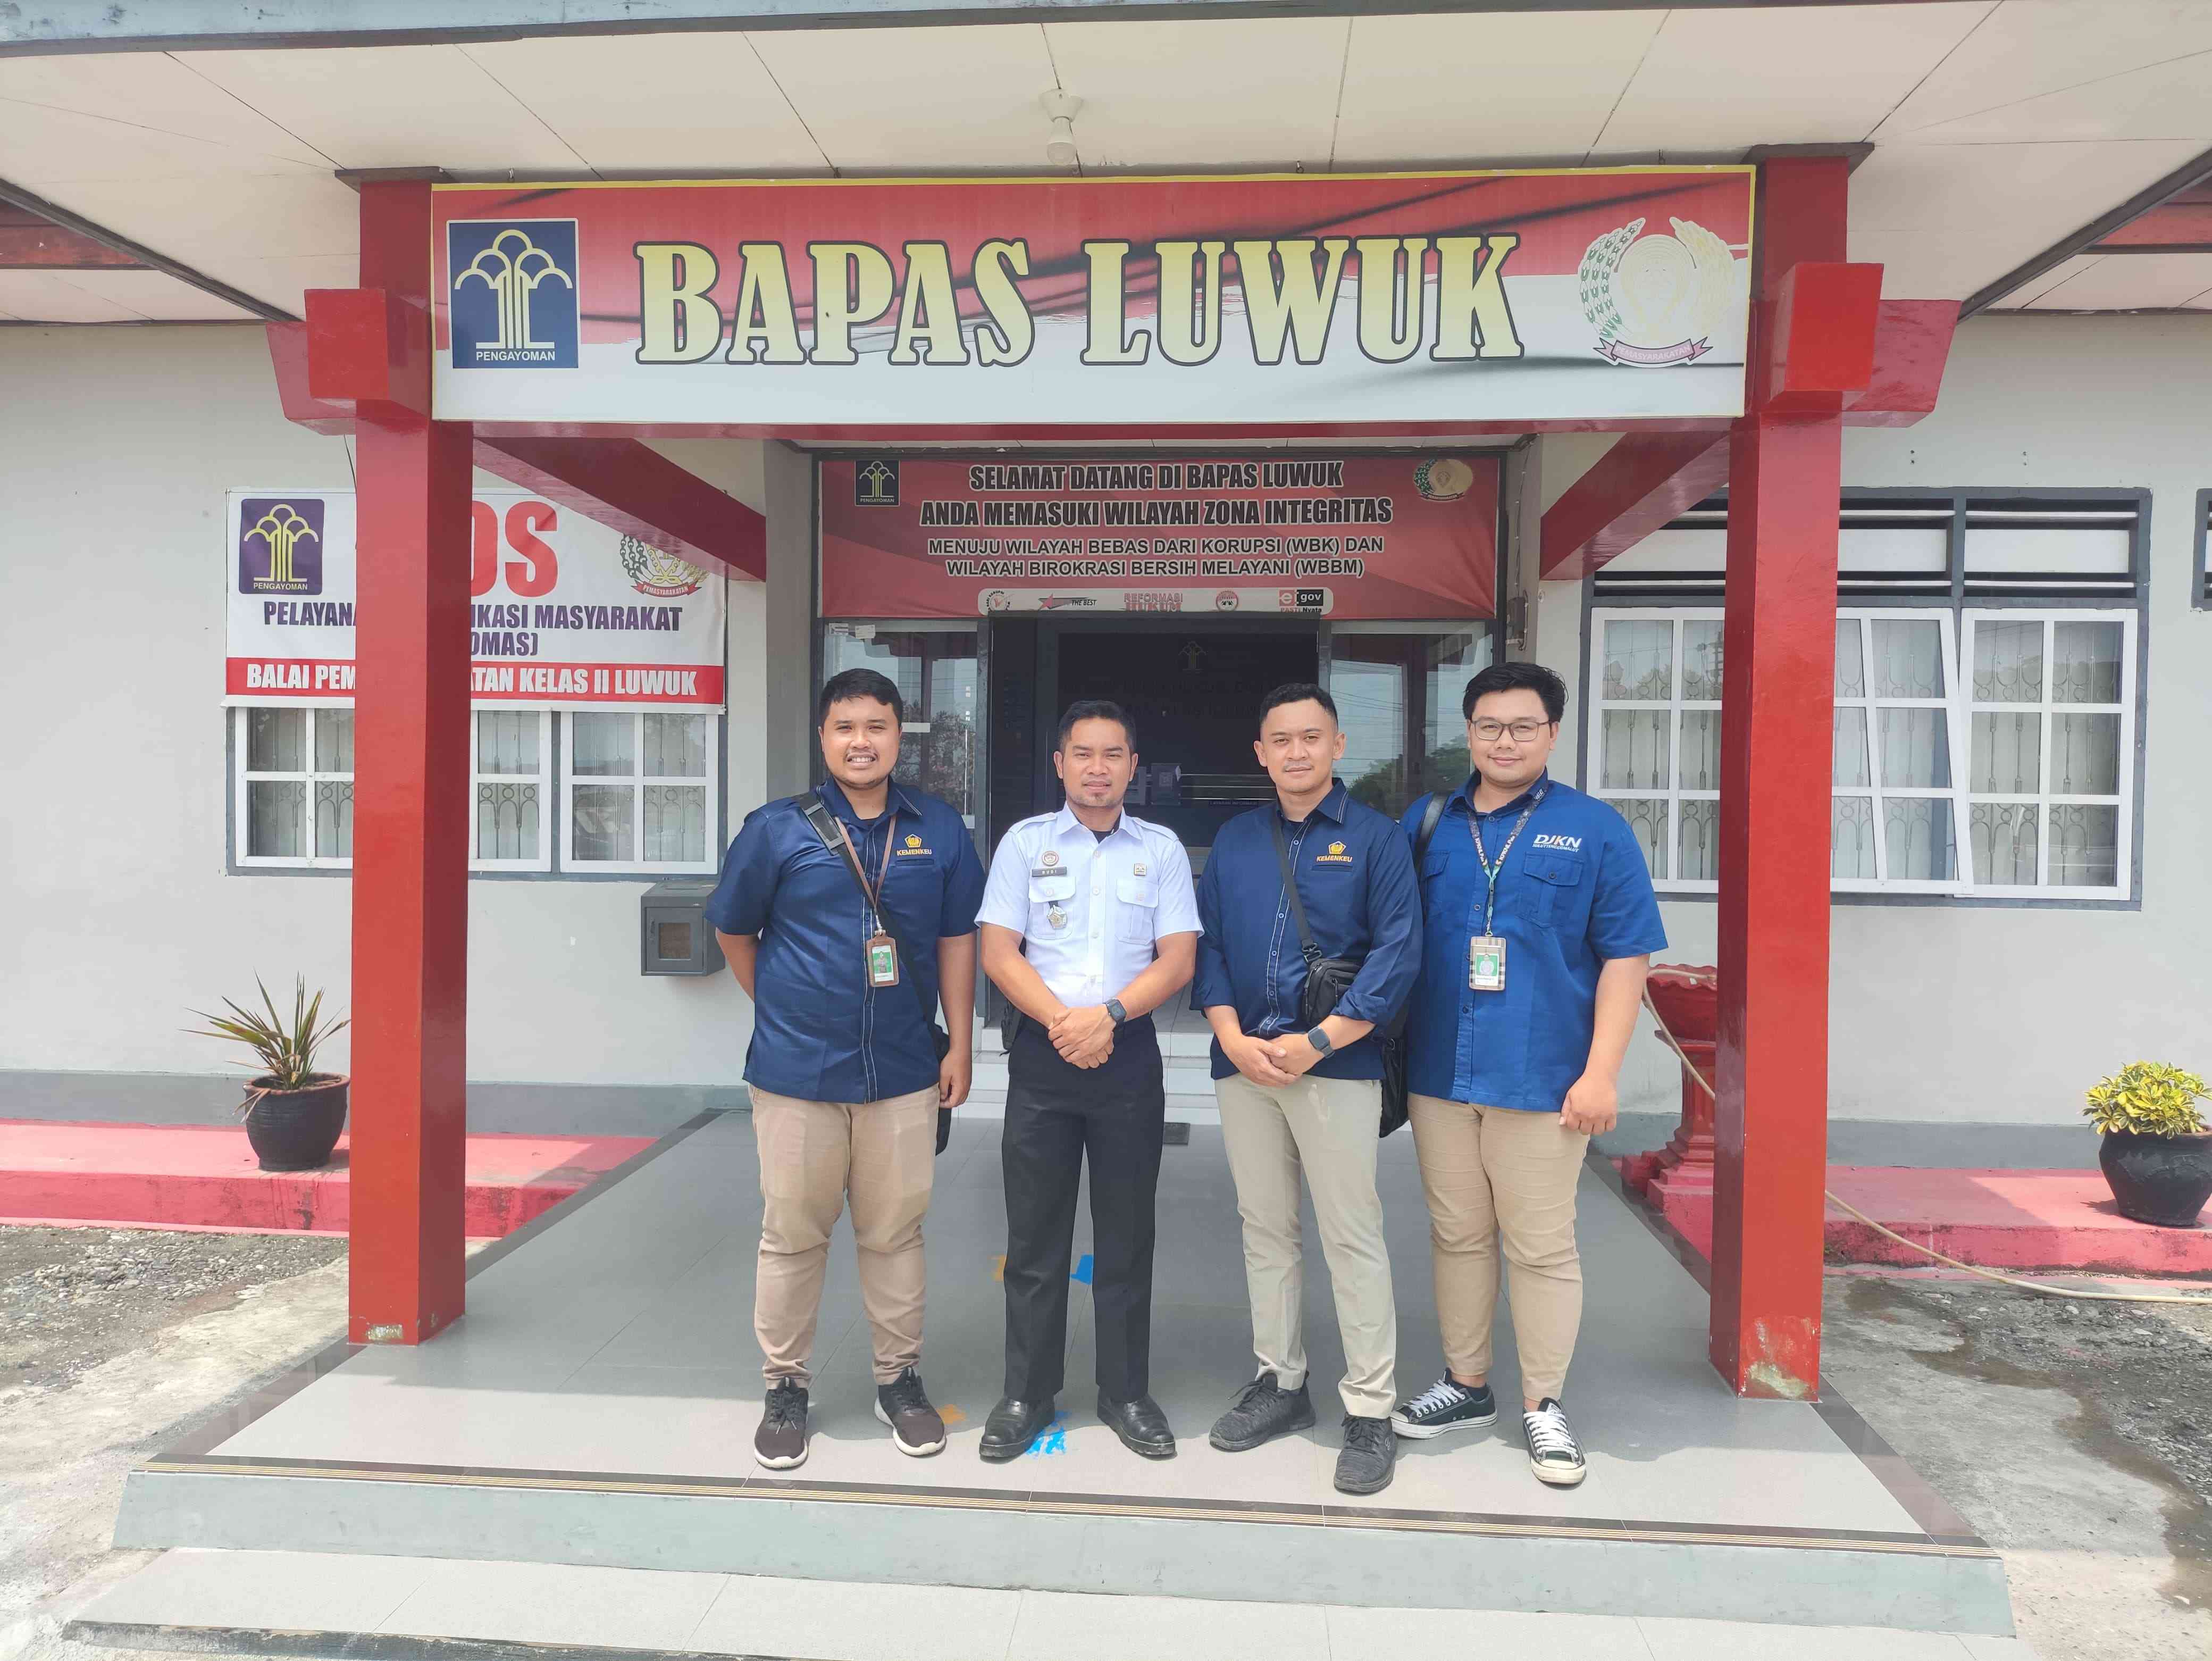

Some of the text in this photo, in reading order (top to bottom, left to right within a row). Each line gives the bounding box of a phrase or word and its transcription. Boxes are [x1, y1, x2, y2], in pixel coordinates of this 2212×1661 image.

[633, 232, 1524, 367] BAPAS LUWUK
[475, 350, 556, 361] PENGAYOMAN
[1614, 346, 1691, 361] PEMASYARAKATAN
[970, 462, 1343, 490] SELAMAT DATANG DI BAPAS LUWUK
[920, 498, 1393, 526] ANDA MEMASUKI WILAYAH ZONA INTEGRITAS
[928, 537, 1384, 556] MENUJU WILAYAH BEBAS DARI KORUPSI (WBK) DAN
[946, 559, 1364, 578] WILAYAH BIROKRASI BERSIH MELAYANI (WBBM)
[642, 586, 689, 596] PEMASYARAKATAN
[1124, 592, 1183, 602] REFORMASI
[264, 601, 356, 626] PELAYAN
[534, 605, 683, 631] MASYARAKAT
[246, 663, 310, 689] BALAI
[519, 667, 589, 694] KELAS
[593, 669, 609, 694] II
[615, 669, 698, 696] LUWUK
[1534, 834, 1582, 848] DJKN
